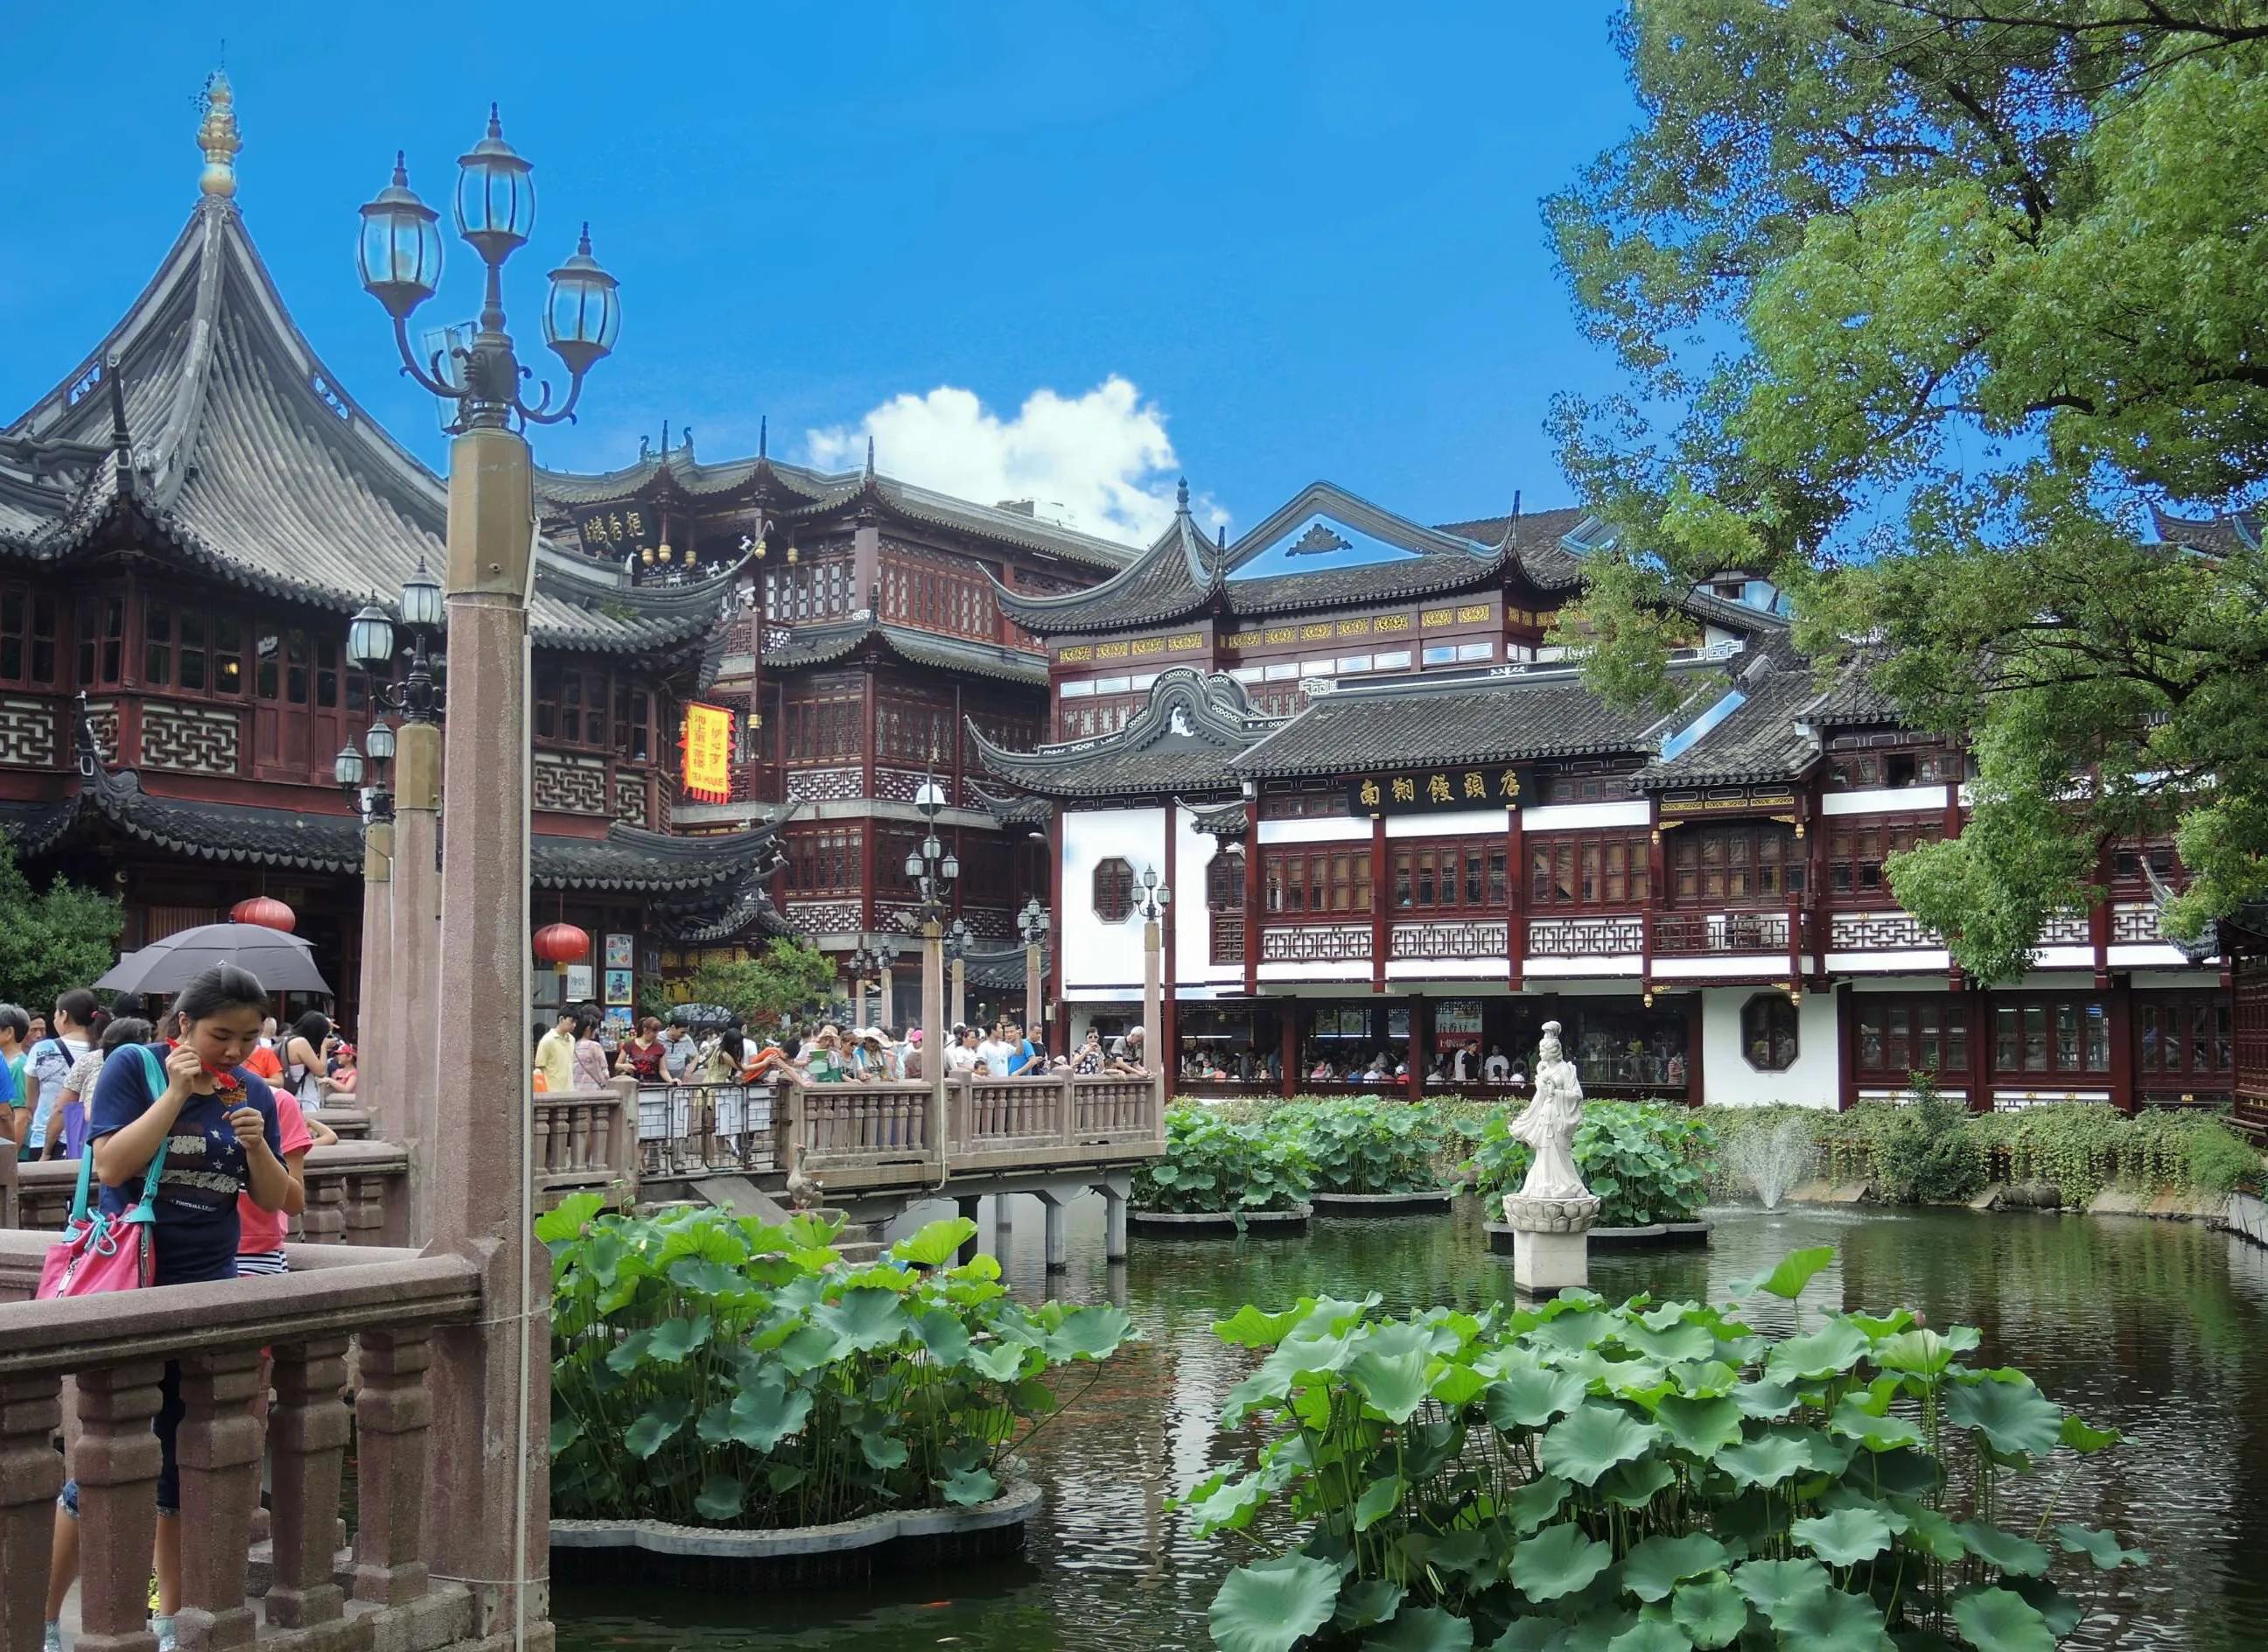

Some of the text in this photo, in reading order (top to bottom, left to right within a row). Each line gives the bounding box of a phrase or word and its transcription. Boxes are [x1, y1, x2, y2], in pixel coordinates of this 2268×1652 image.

[1360, 769, 1522, 807] 南翔饅頭店
